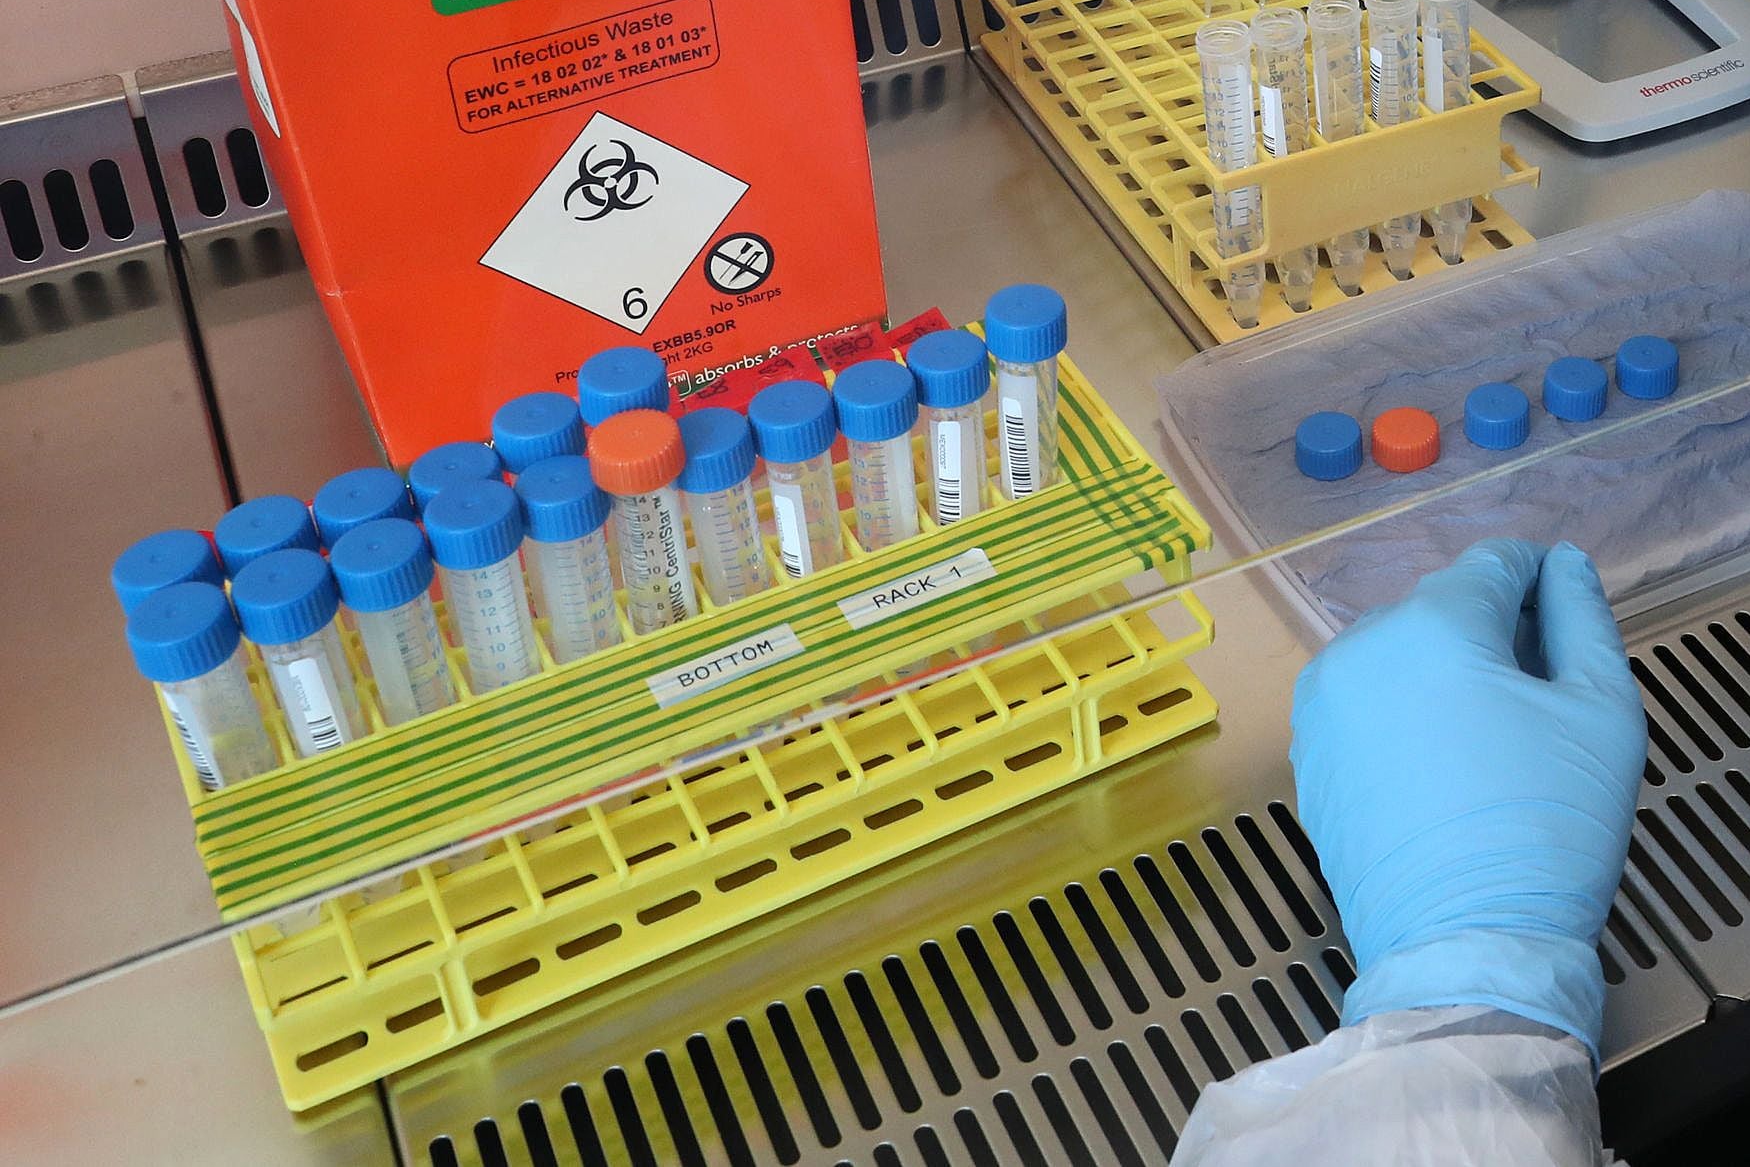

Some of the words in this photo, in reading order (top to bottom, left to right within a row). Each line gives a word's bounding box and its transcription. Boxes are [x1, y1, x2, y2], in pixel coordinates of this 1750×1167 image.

[492, 32, 600, 74] Infectious
[605, 11, 674, 41] Waste
[464, 83, 509, 104] EWC
[515, 79, 526, 89] =
[531, 70, 552, 86] 18
[556, 63, 577, 79] 02
[614, 48, 627, 62] &
[632, 41, 652, 57] 18
[656, 34, 676, 50] 01
[467, 104, 503, 123] FOR
[507, 72, 616, 113] ALTERNATIVE
[620, 44, 712, 81] TREATMENT
[622, 287, 648, 320] 6
[709, 302, 734, 316] No
[736, 287, 782, 309] Sharps
[683, 341, 714, 360] 2KG
[872, 575, 937, 609] RACK
[949, 565, 964, 579] 1
[676, 638, 775, 688] BOTTOM
